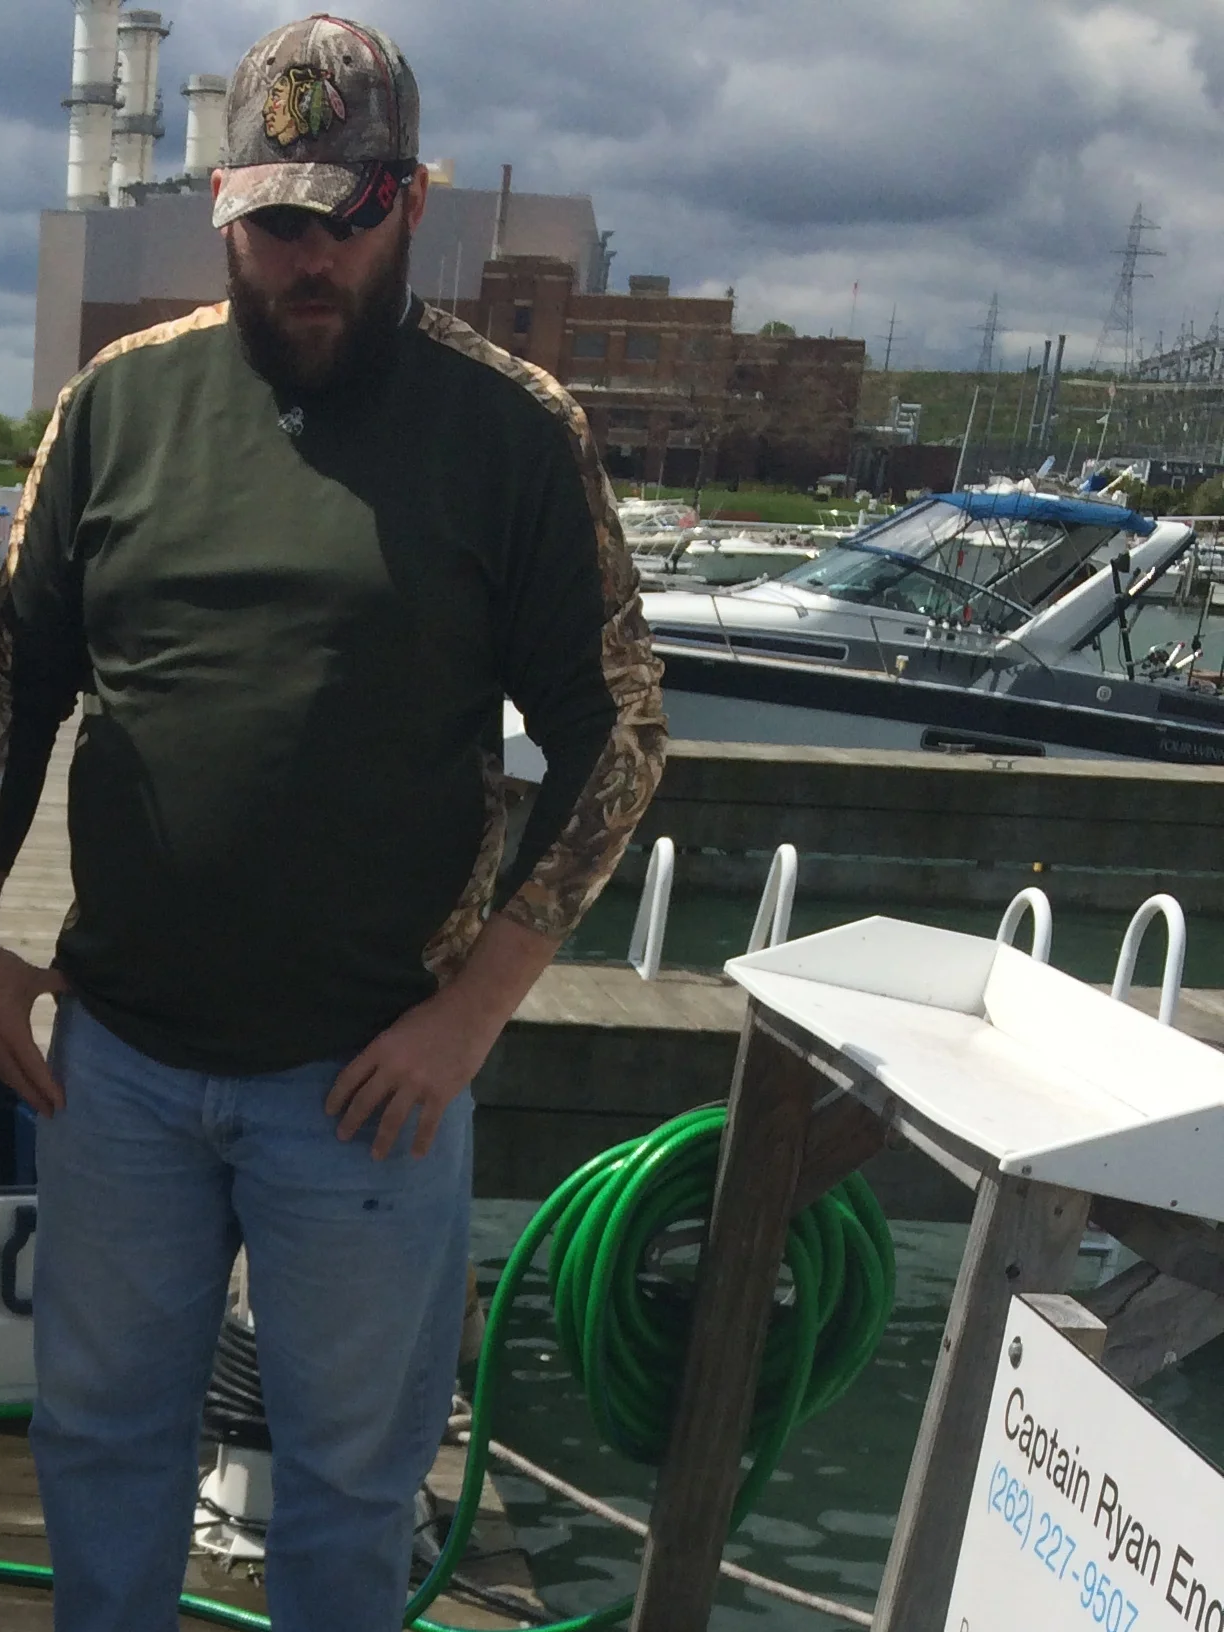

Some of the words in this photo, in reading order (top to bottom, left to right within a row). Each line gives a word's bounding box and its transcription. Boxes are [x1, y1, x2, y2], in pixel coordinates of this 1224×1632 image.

[987, 1460, 1034, 1550] (262)
[1005, 1387, 1090, 1513] Captain
[1093, 1473, 1161, 1586] Ryan
